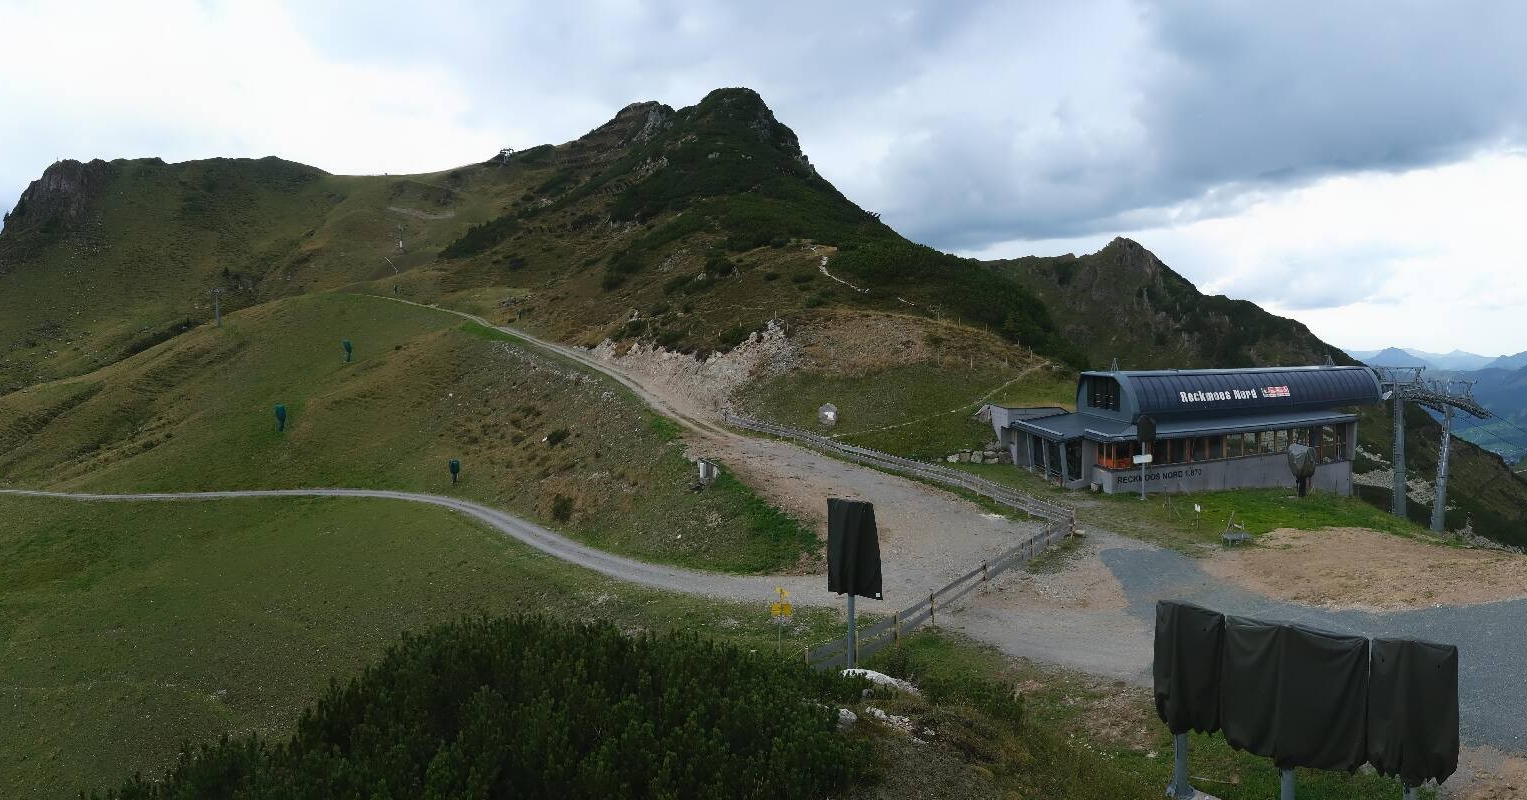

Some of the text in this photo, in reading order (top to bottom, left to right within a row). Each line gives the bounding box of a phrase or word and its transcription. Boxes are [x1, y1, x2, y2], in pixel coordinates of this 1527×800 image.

[1180, 391, 1232, 403] Reckmoos
[1233, 389, 1258, 400] Nord
[1163, 470, 1183, 480] NORD
[1185, 469, 1202, 477] 1.870
